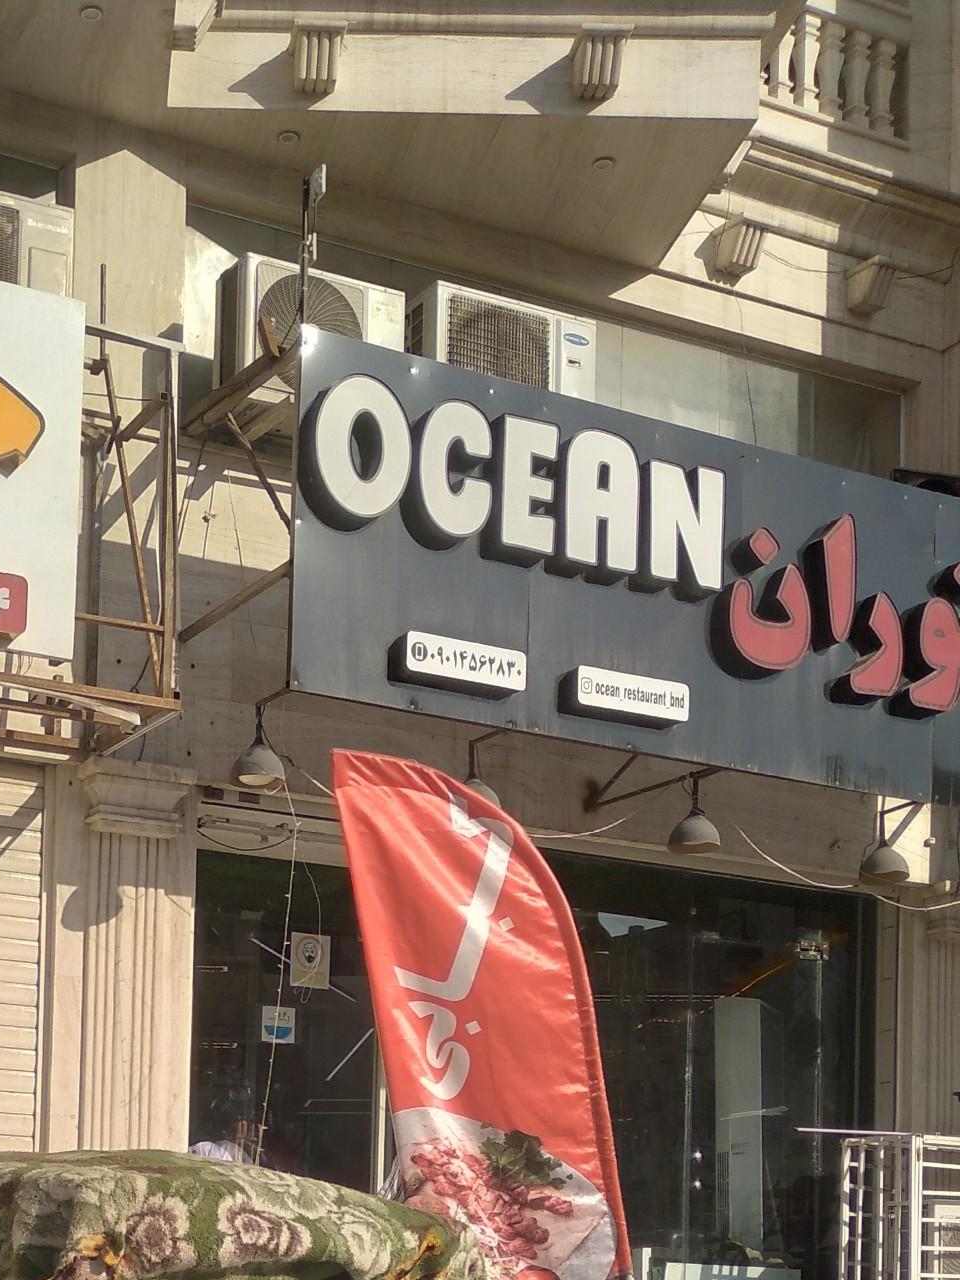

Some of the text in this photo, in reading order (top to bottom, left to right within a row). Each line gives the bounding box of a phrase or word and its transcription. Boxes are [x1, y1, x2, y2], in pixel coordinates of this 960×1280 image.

[315, 373, 726, 592] OCEAN
[430, 646, 522, 678] ۰۹۰۱۴۵۶۲۸۳۰
[730, 512, 960, 712] وران
[595, 681, 685, 709] ocean_restaurant_bnd
